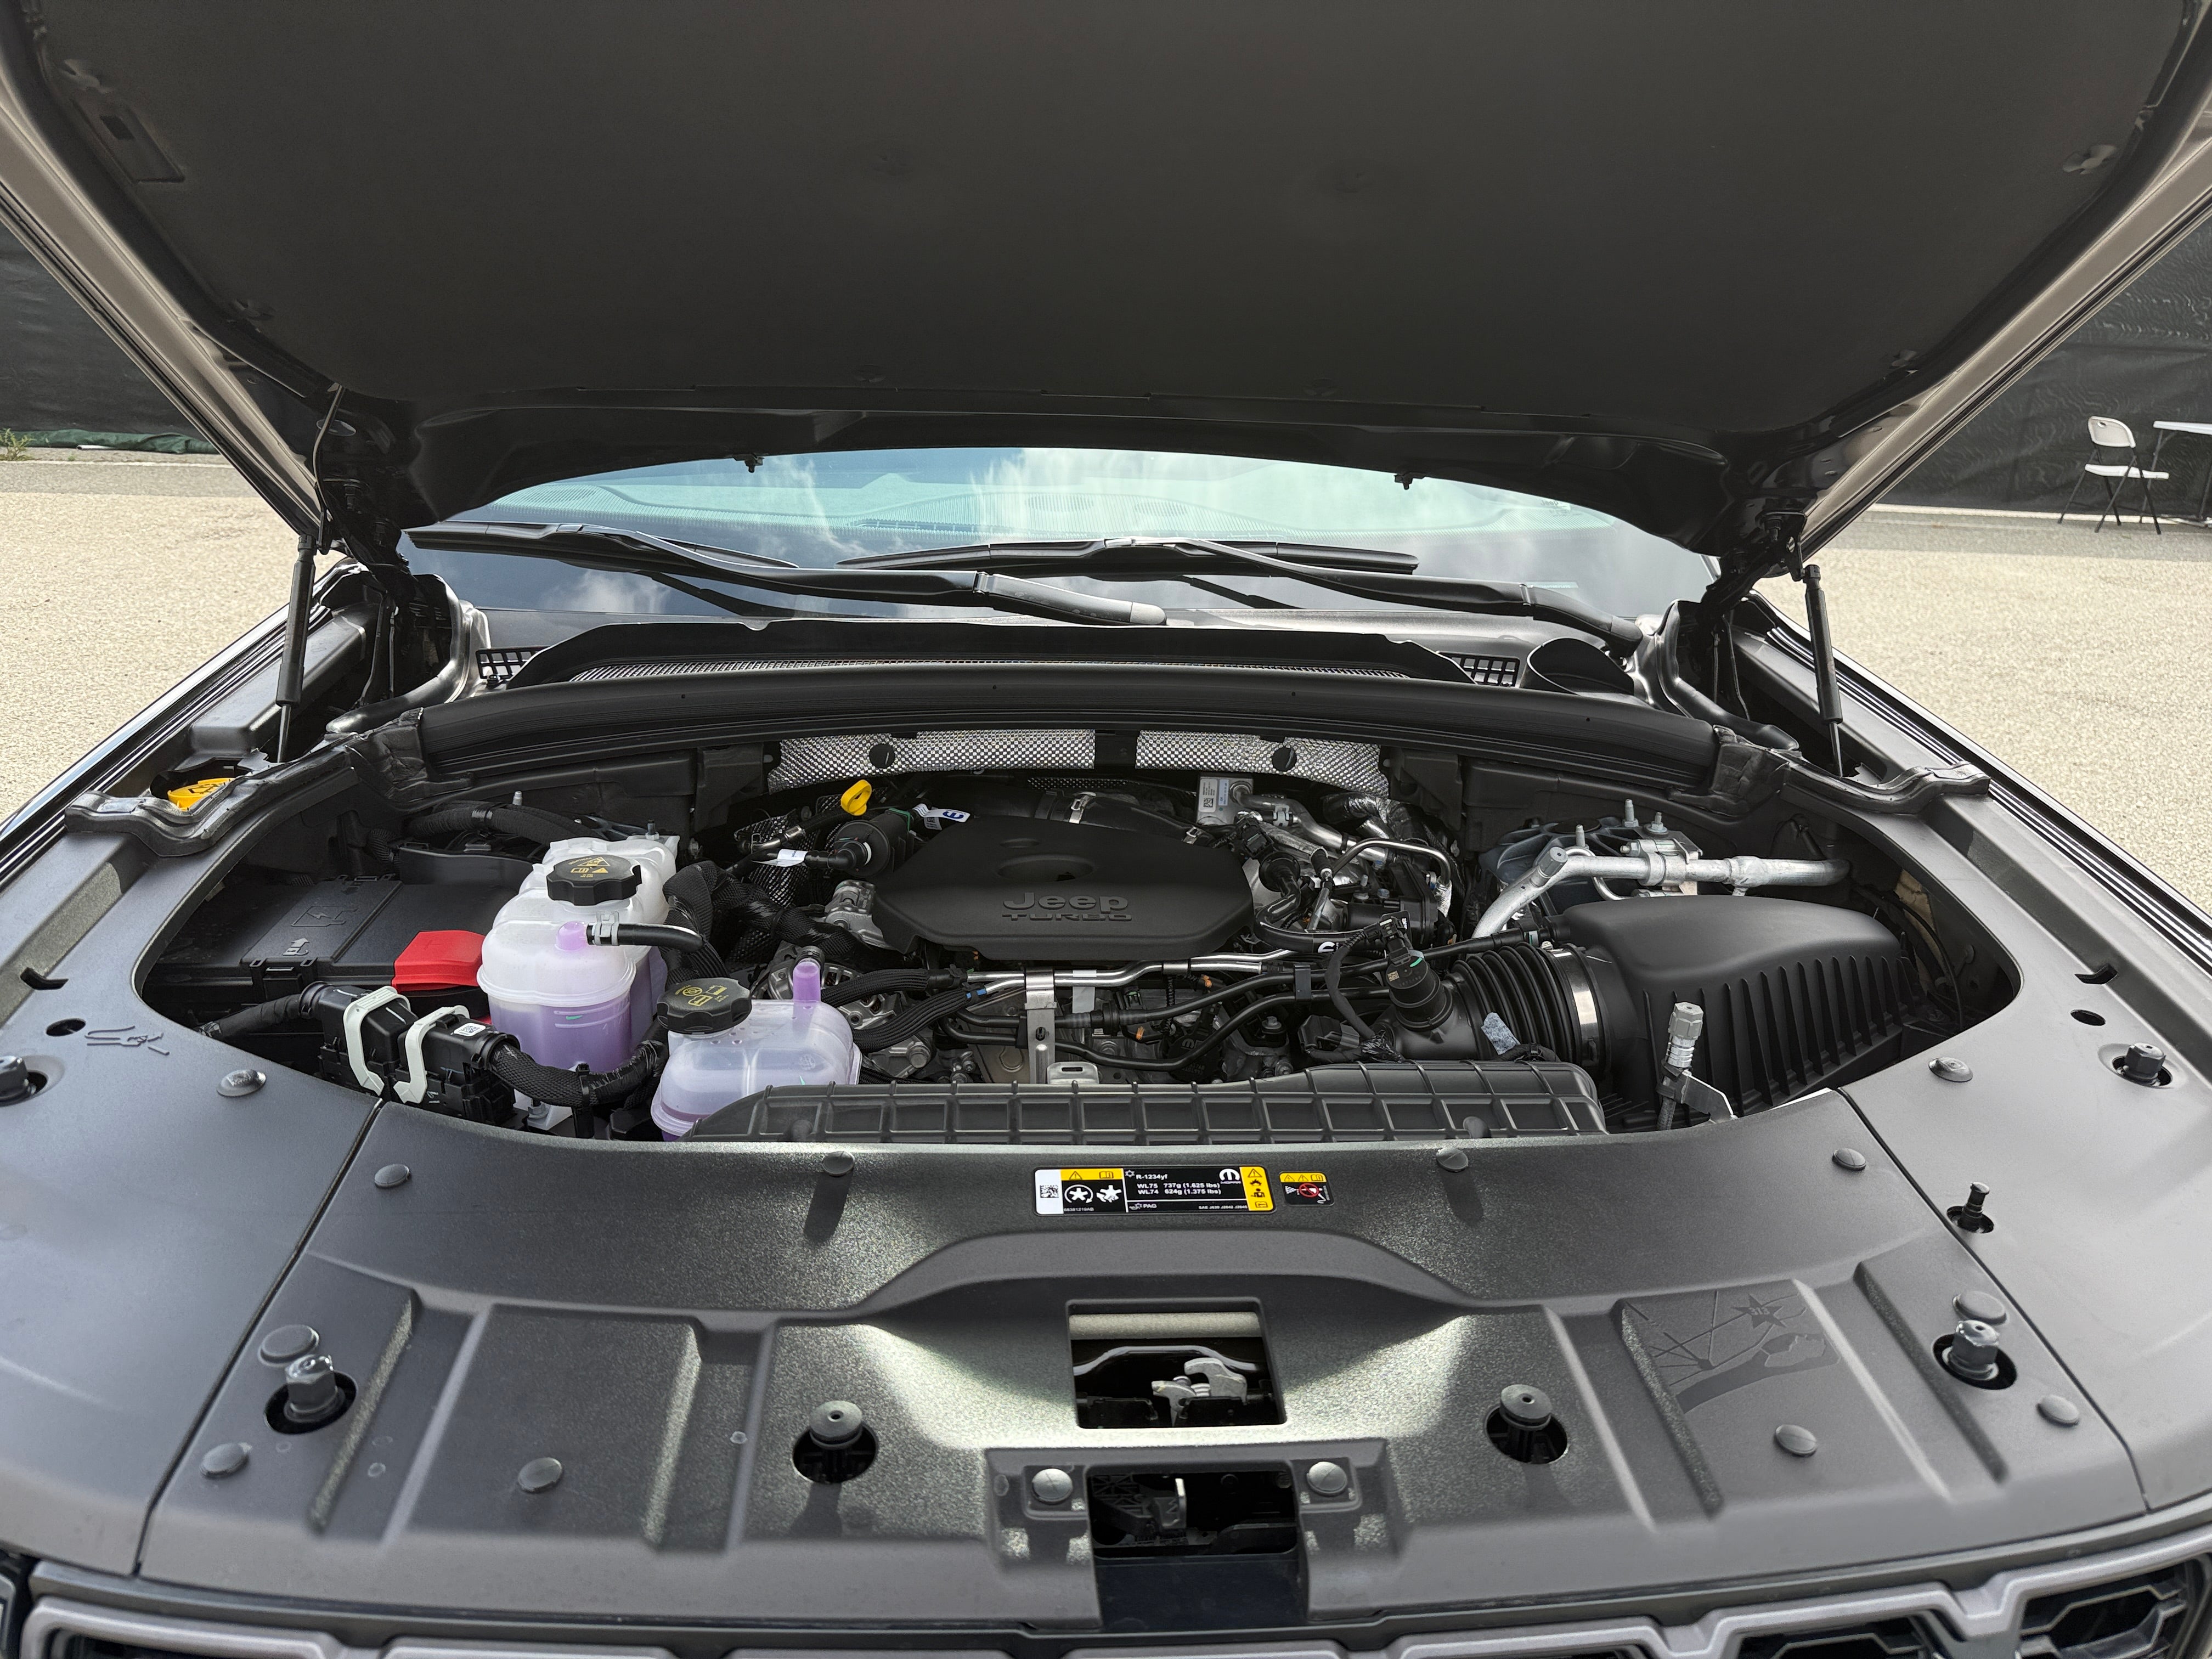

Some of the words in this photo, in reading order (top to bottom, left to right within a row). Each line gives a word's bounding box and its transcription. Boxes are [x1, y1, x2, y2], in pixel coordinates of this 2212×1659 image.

[1003, 892, 1128, 914] Jeep
[1002, 913, 1132, 921] TURBO
[1748, 1307, 1770, 1316] 313
